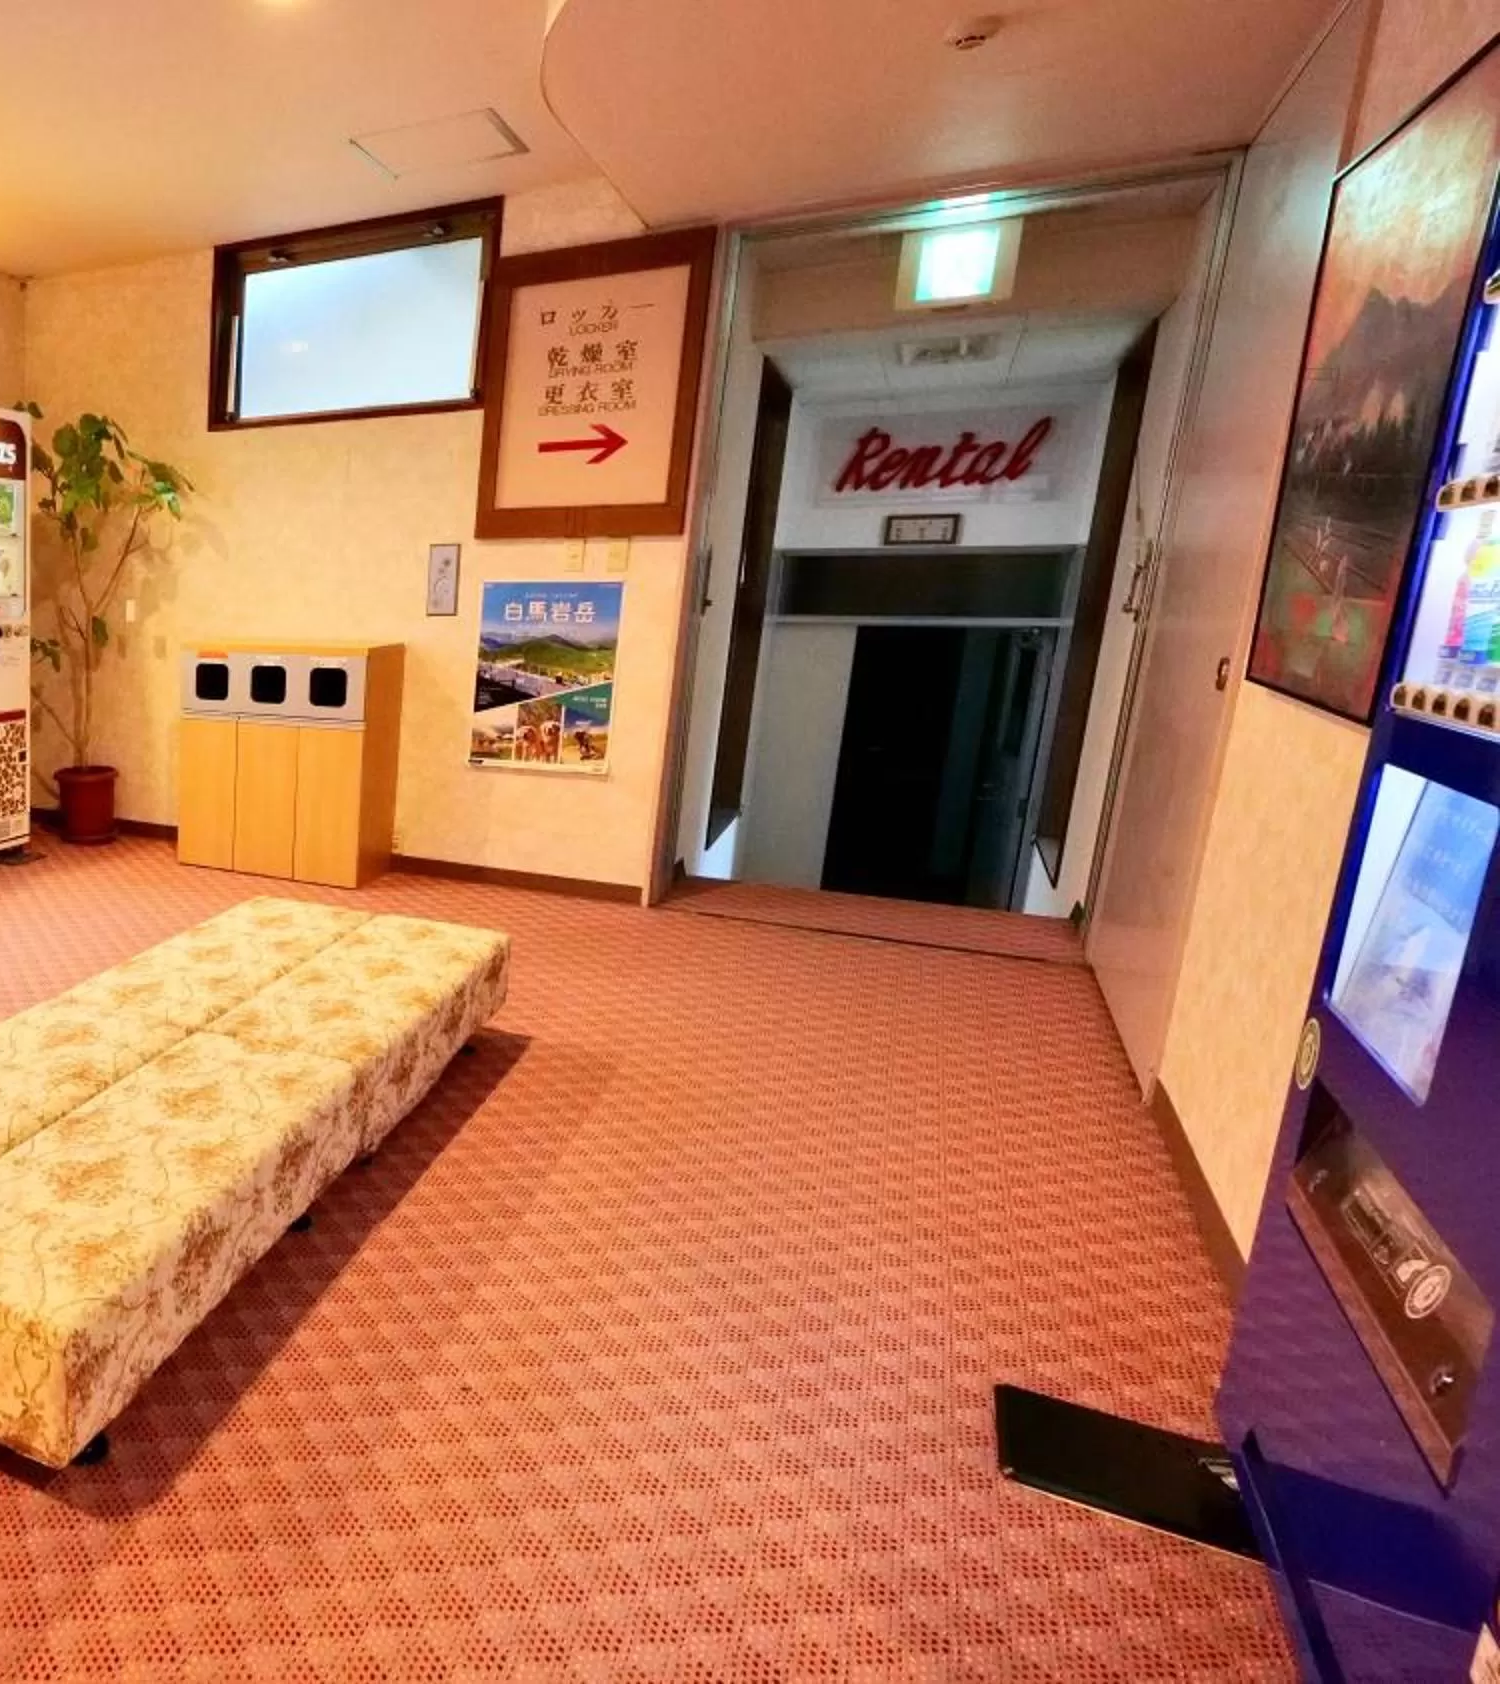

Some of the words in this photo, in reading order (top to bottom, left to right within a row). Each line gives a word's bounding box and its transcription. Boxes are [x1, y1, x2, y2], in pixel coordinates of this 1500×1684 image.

[540, 299, 656, 327] ロッカー
[547, 339, 639, 367] 乾燥室
[547, 366, 592, 379] DRYING
[595, 360, 633, 374] ROOM
[544, 378, 635, 405] 更衣室
[538, 403, 596, 417] DRESSING
[598, 399, 637, 412] ROOM
[835, 415, 1056, 493] Rental
[504, 600, 596, 624] 白馬岩岳
